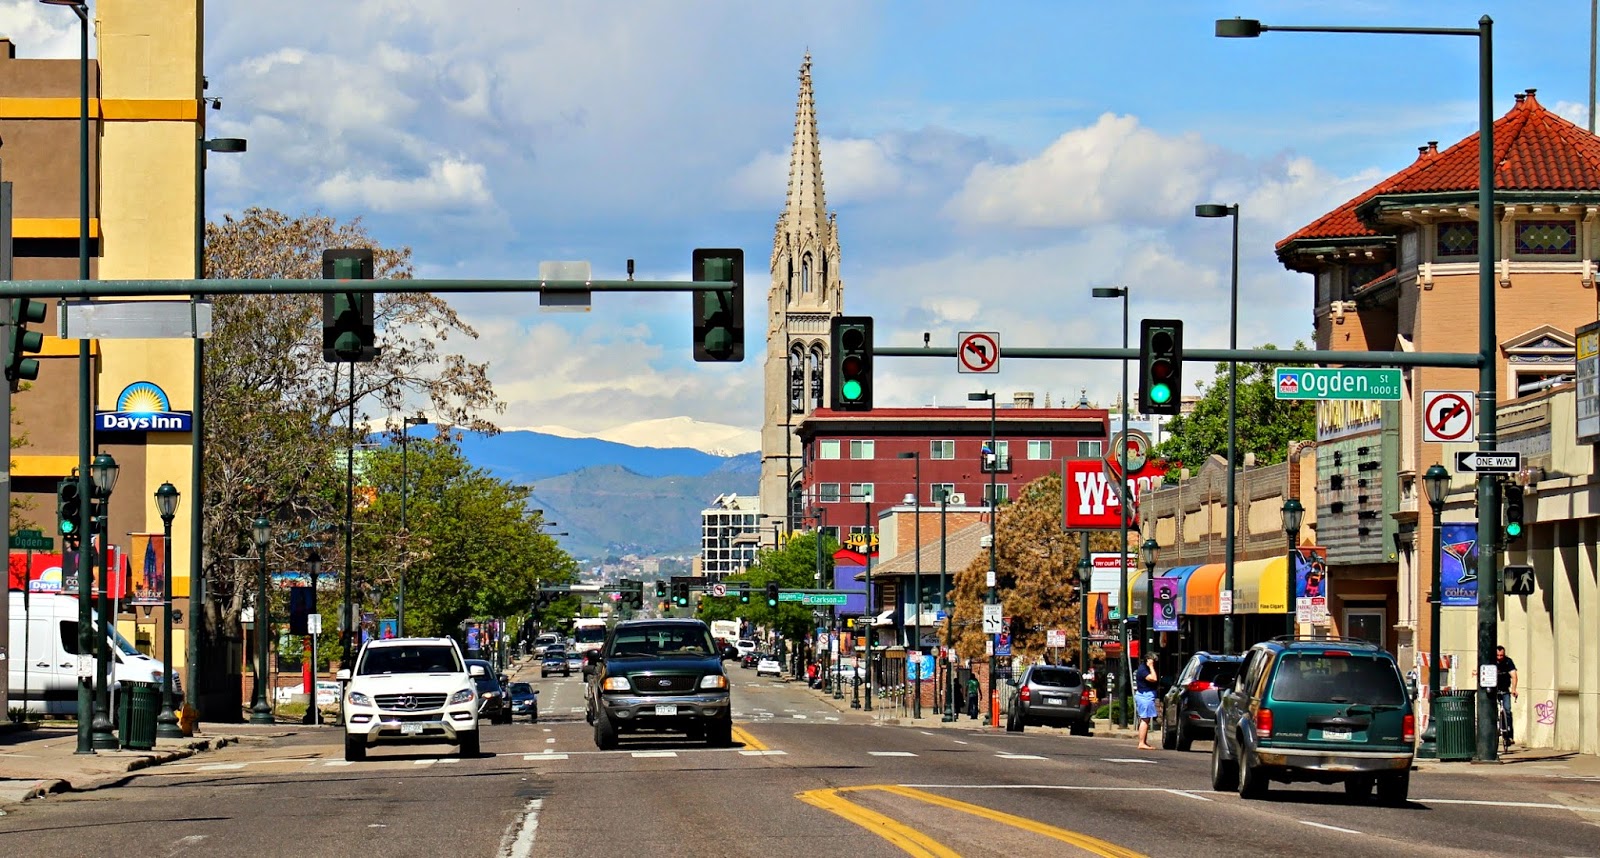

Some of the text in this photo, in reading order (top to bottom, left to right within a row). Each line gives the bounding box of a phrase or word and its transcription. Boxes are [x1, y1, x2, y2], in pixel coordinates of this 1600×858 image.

[1379, 374, 1389, 383] St
[1301, 371, 1368, 397] Ogden
[1370, 386, 1399, 395] 1000 E
[103, 414, 182, 430] Days Inn
[1476, 457, 1513, 466] ONE WAY
[15, 536, 43, 548] Ogden
[33, 581, 58, 591] Days
[810, 596, 837, 604] Clarkson
